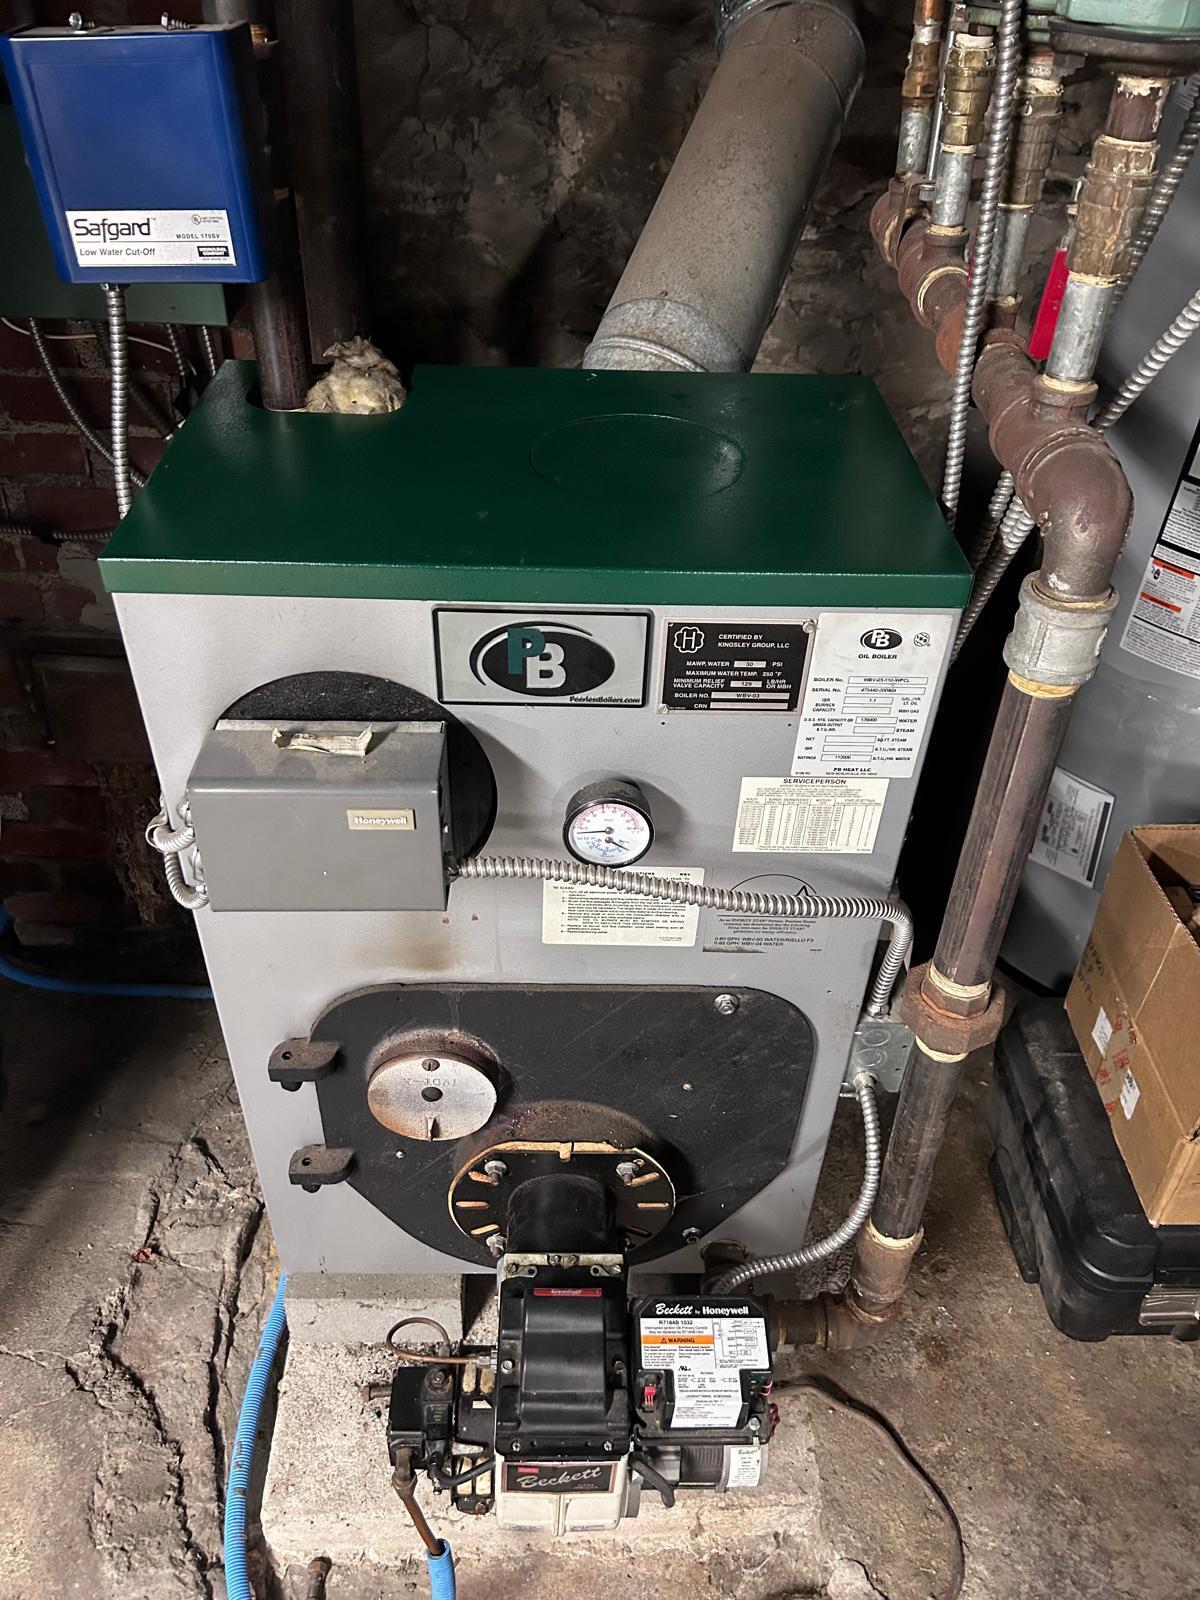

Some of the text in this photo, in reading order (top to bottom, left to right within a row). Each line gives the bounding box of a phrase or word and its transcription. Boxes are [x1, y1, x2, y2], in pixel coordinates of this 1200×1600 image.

[74, 218, 151, 243] Safgard
[80, 248, 156, 256] Low Water Cut-Off
[870, 630, 890, 648] PB
[507, 627, 566, 689] PB
[569, 695, 640, 704] PeerlessBoilers.com
[354, 816, 408, 826] Honeywell
[655, 1302, 694, 1315] Beckett
[702, 1306, 749, 1316] Honeywell
[516, 1466, 602, 1488] Beckett
